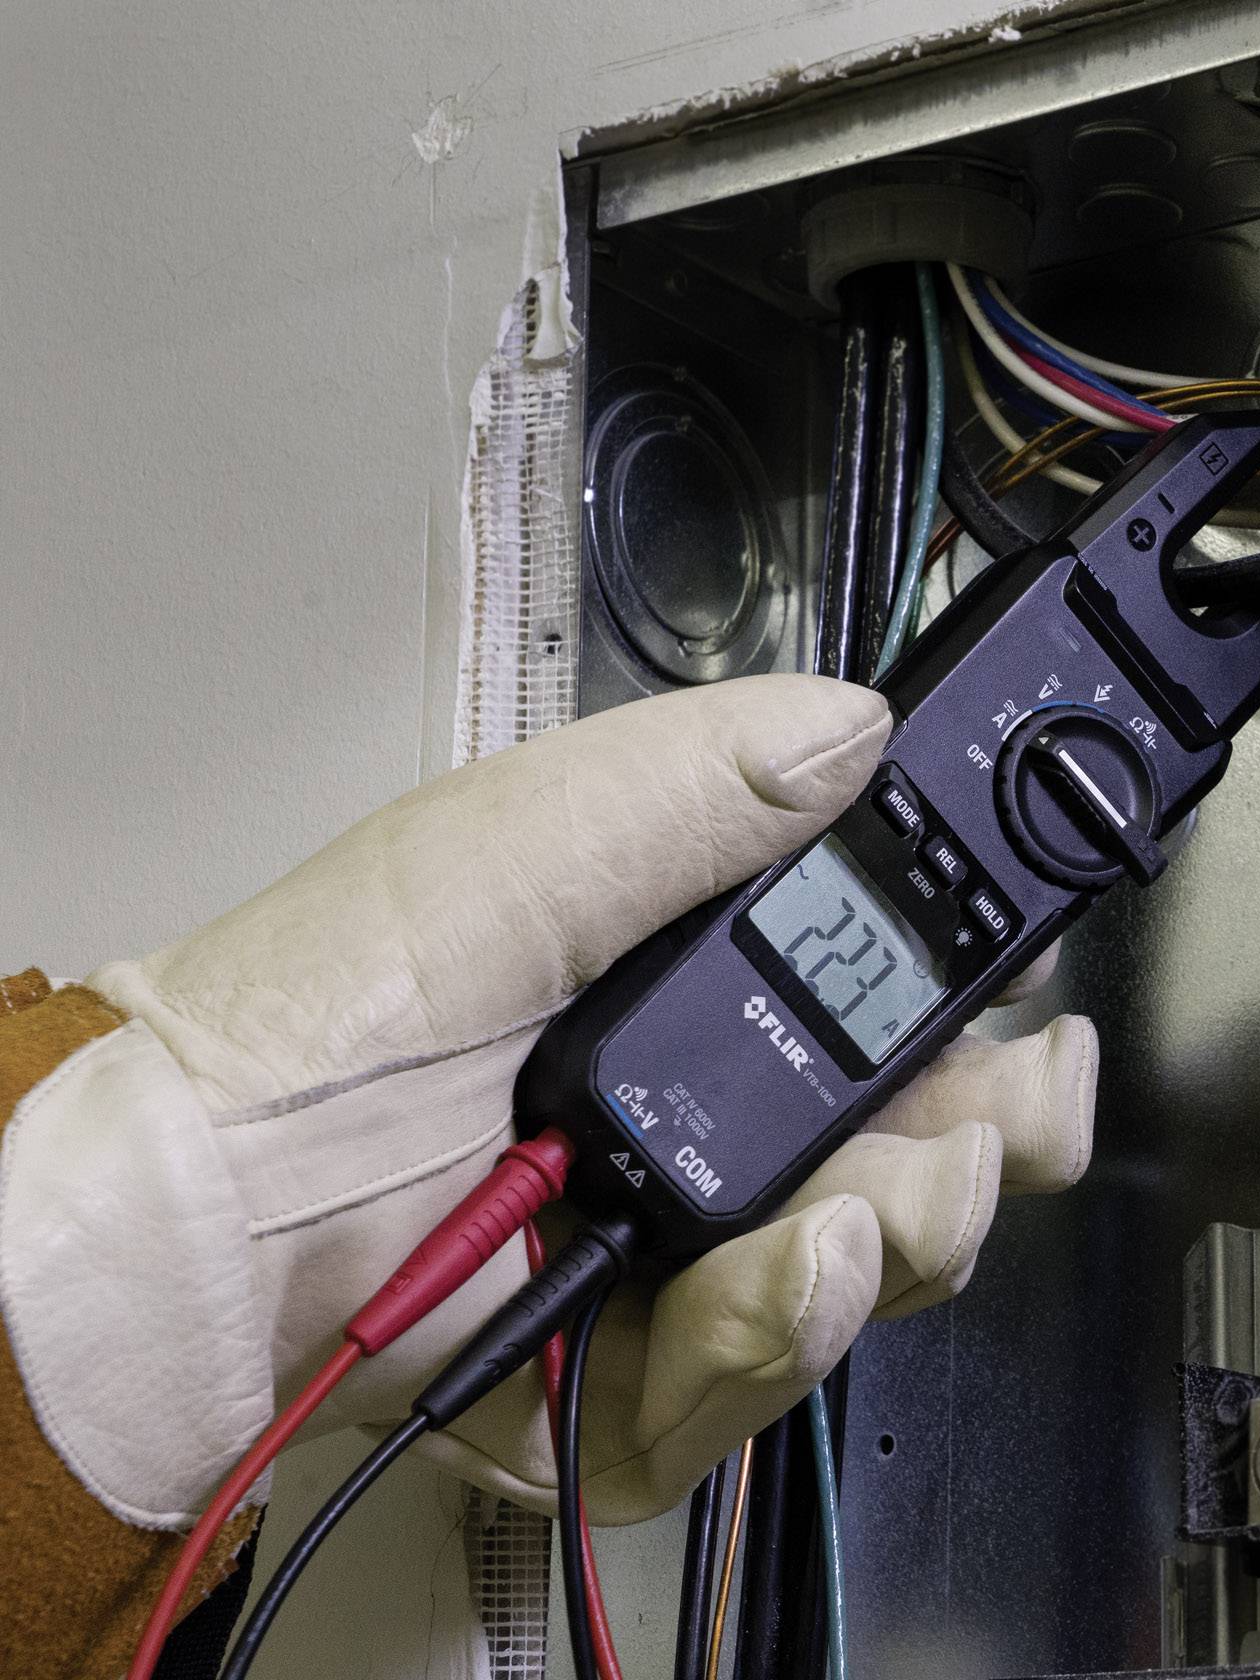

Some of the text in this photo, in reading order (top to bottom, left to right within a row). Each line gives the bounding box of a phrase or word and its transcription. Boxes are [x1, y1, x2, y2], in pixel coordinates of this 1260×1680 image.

[966, 743, 993, 771] OFF
[887, 789, 921, 828] MODE
[936, 846, 957, 875] REL
[907, 867, 935, 899] ZERO
[975, 895, 1005, 930] HOLD
[758, 1011, 836, 1108] FLIR VT8-1000
[663, 1088, 709, 1140] CAT III 1000V
[673, 1082, 716, 1130] CAT IV 600V
[675, 1145, 723, 1198] COM
